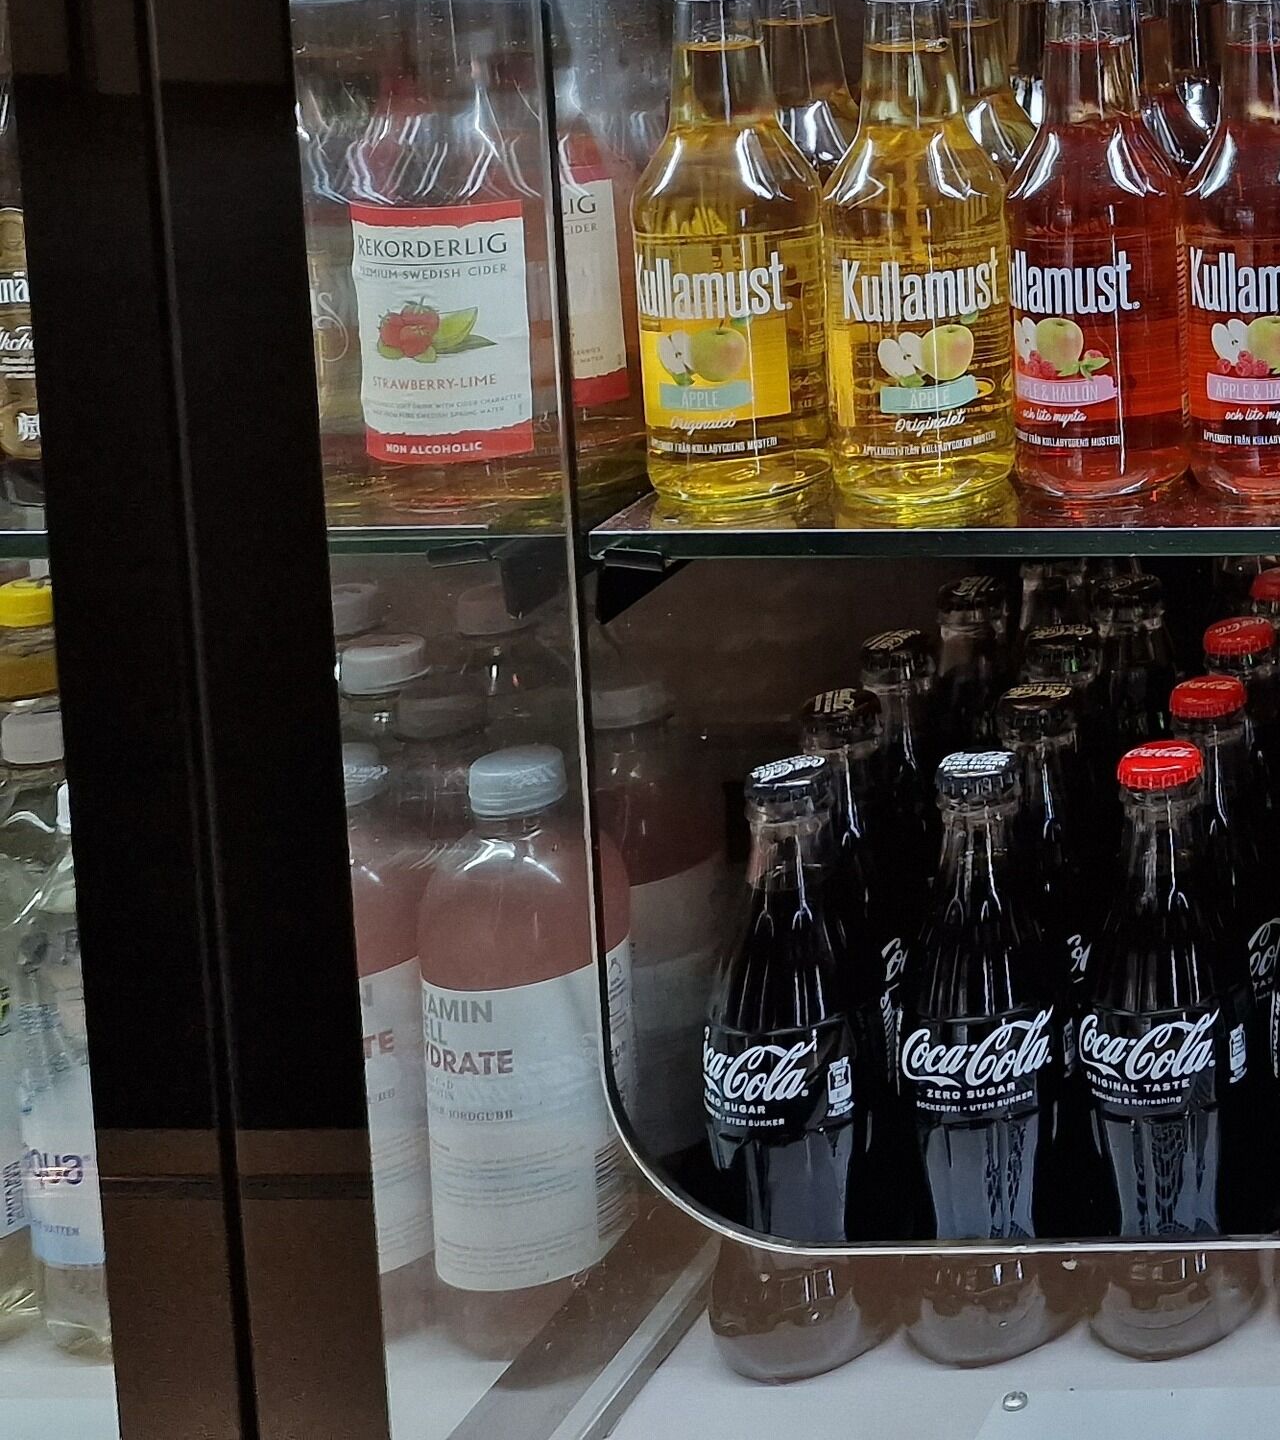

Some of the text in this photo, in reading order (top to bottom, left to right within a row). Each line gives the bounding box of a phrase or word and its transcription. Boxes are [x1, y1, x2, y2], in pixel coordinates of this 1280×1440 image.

[358, 233, 507, 258] REKORDERLIG
[403, 264, 507, 280] SWEDISH CIDER
[841, 247, 1000, 322] Kullamust
[373, 373, 497, 391] STRAWBERRY-LIME
[1215, 380, 1250, 401] ÄPPLE
[910, 388, 950, 407] ÄPPLE
[1050, 383, 1098, 401] HALLON
[895, 411, 966, 437] Originalet
[386, 441, 483, 455] NON ALCOHOLIC
[1126, 746, 1193, 758] Coca-Cola
[902, 1006, 1054, 1088] Coca-Cola
[1079, 1008, 1220, 1080] Coca-Cola
[927, 1082, 1016, 1100] ZERO SUGAR
[1086, 1071, 1190, 1093] ORIGINAL TASTE
[724, 1101, 765, 1114] SUGAR
